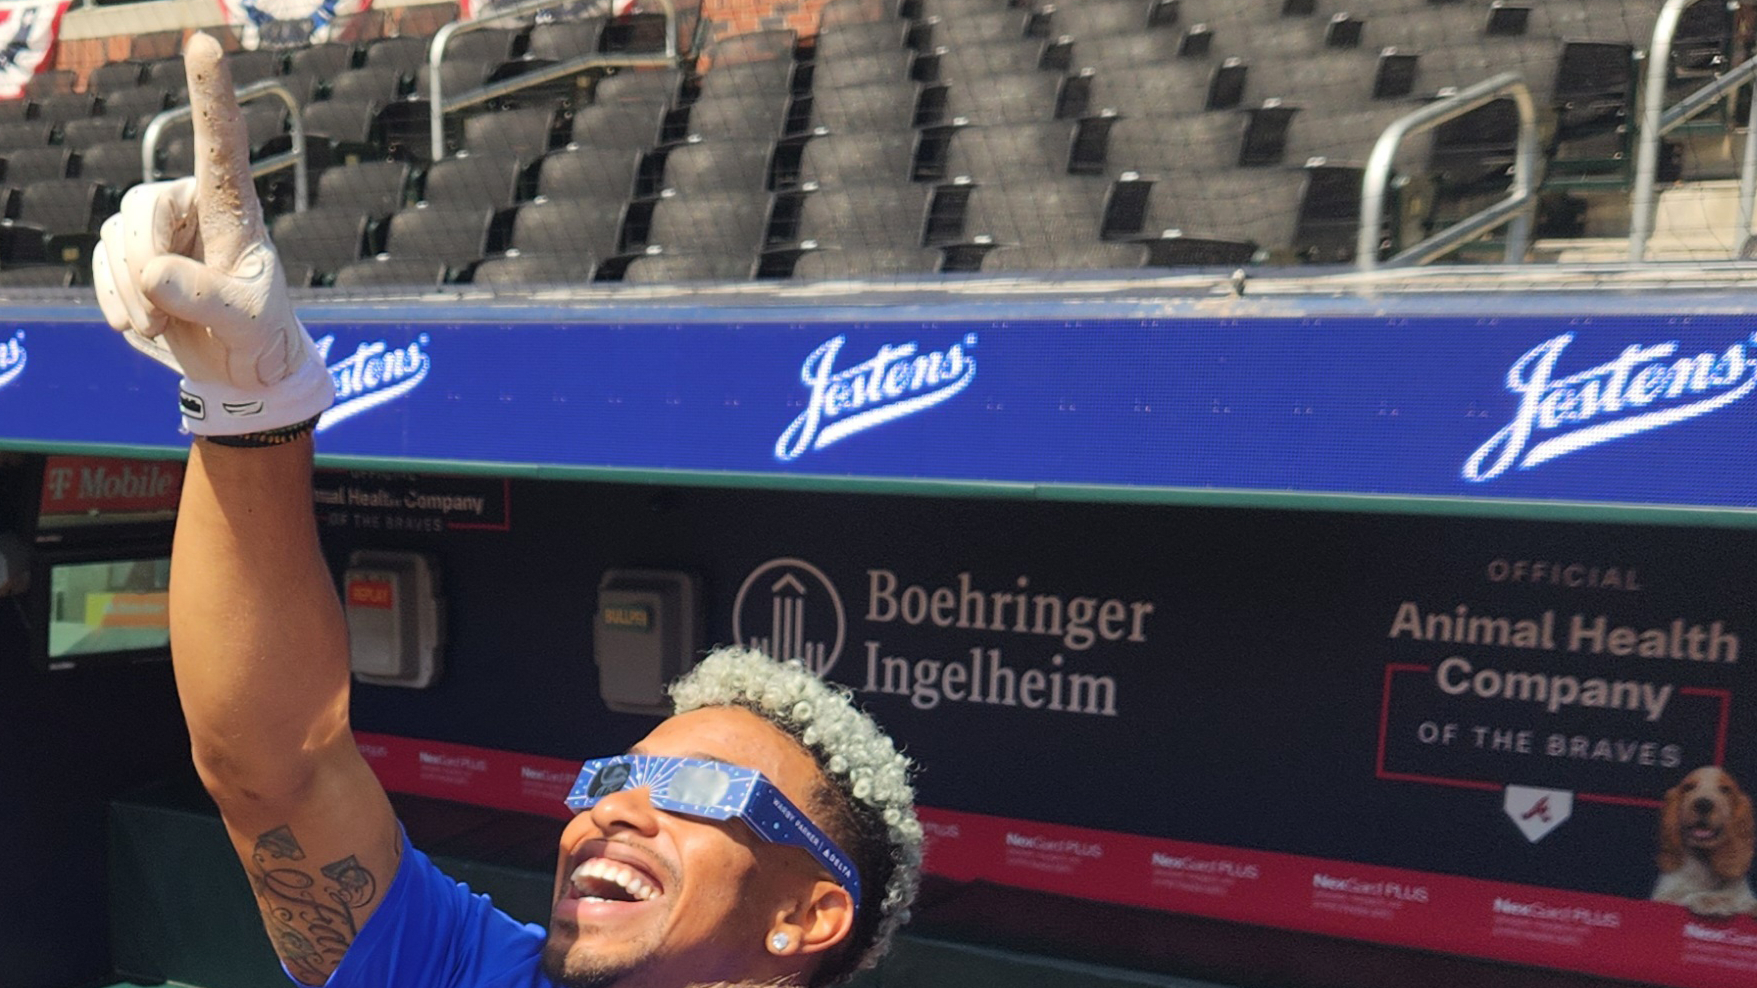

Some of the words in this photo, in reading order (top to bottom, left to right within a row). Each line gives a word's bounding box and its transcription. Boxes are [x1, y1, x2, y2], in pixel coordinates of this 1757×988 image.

[774, 332, 978, 462] Jostens
[1462, 331, 1757, 483] Jostens
[78, 464, 175, 500] Mobile
[1487, 558, 1641, 592] OFFICIAL
[864, 568, 1155, 650] Boehringer
[1387, 600, 1555, 652] Animal
[1567, 612, 1740, 664] Health
[862, 641, 1119, 717] Ingelheim
[1436, 656, 1673, 722] Company
[1417, 720, 1458, 746] OF
[1472, 725, 1535, 755] THE
[1544, 734, 1683, 769] BRAVES
[829, 853, 851, 878] DELTA
[1384, 881, 1429, 902] PLUS
